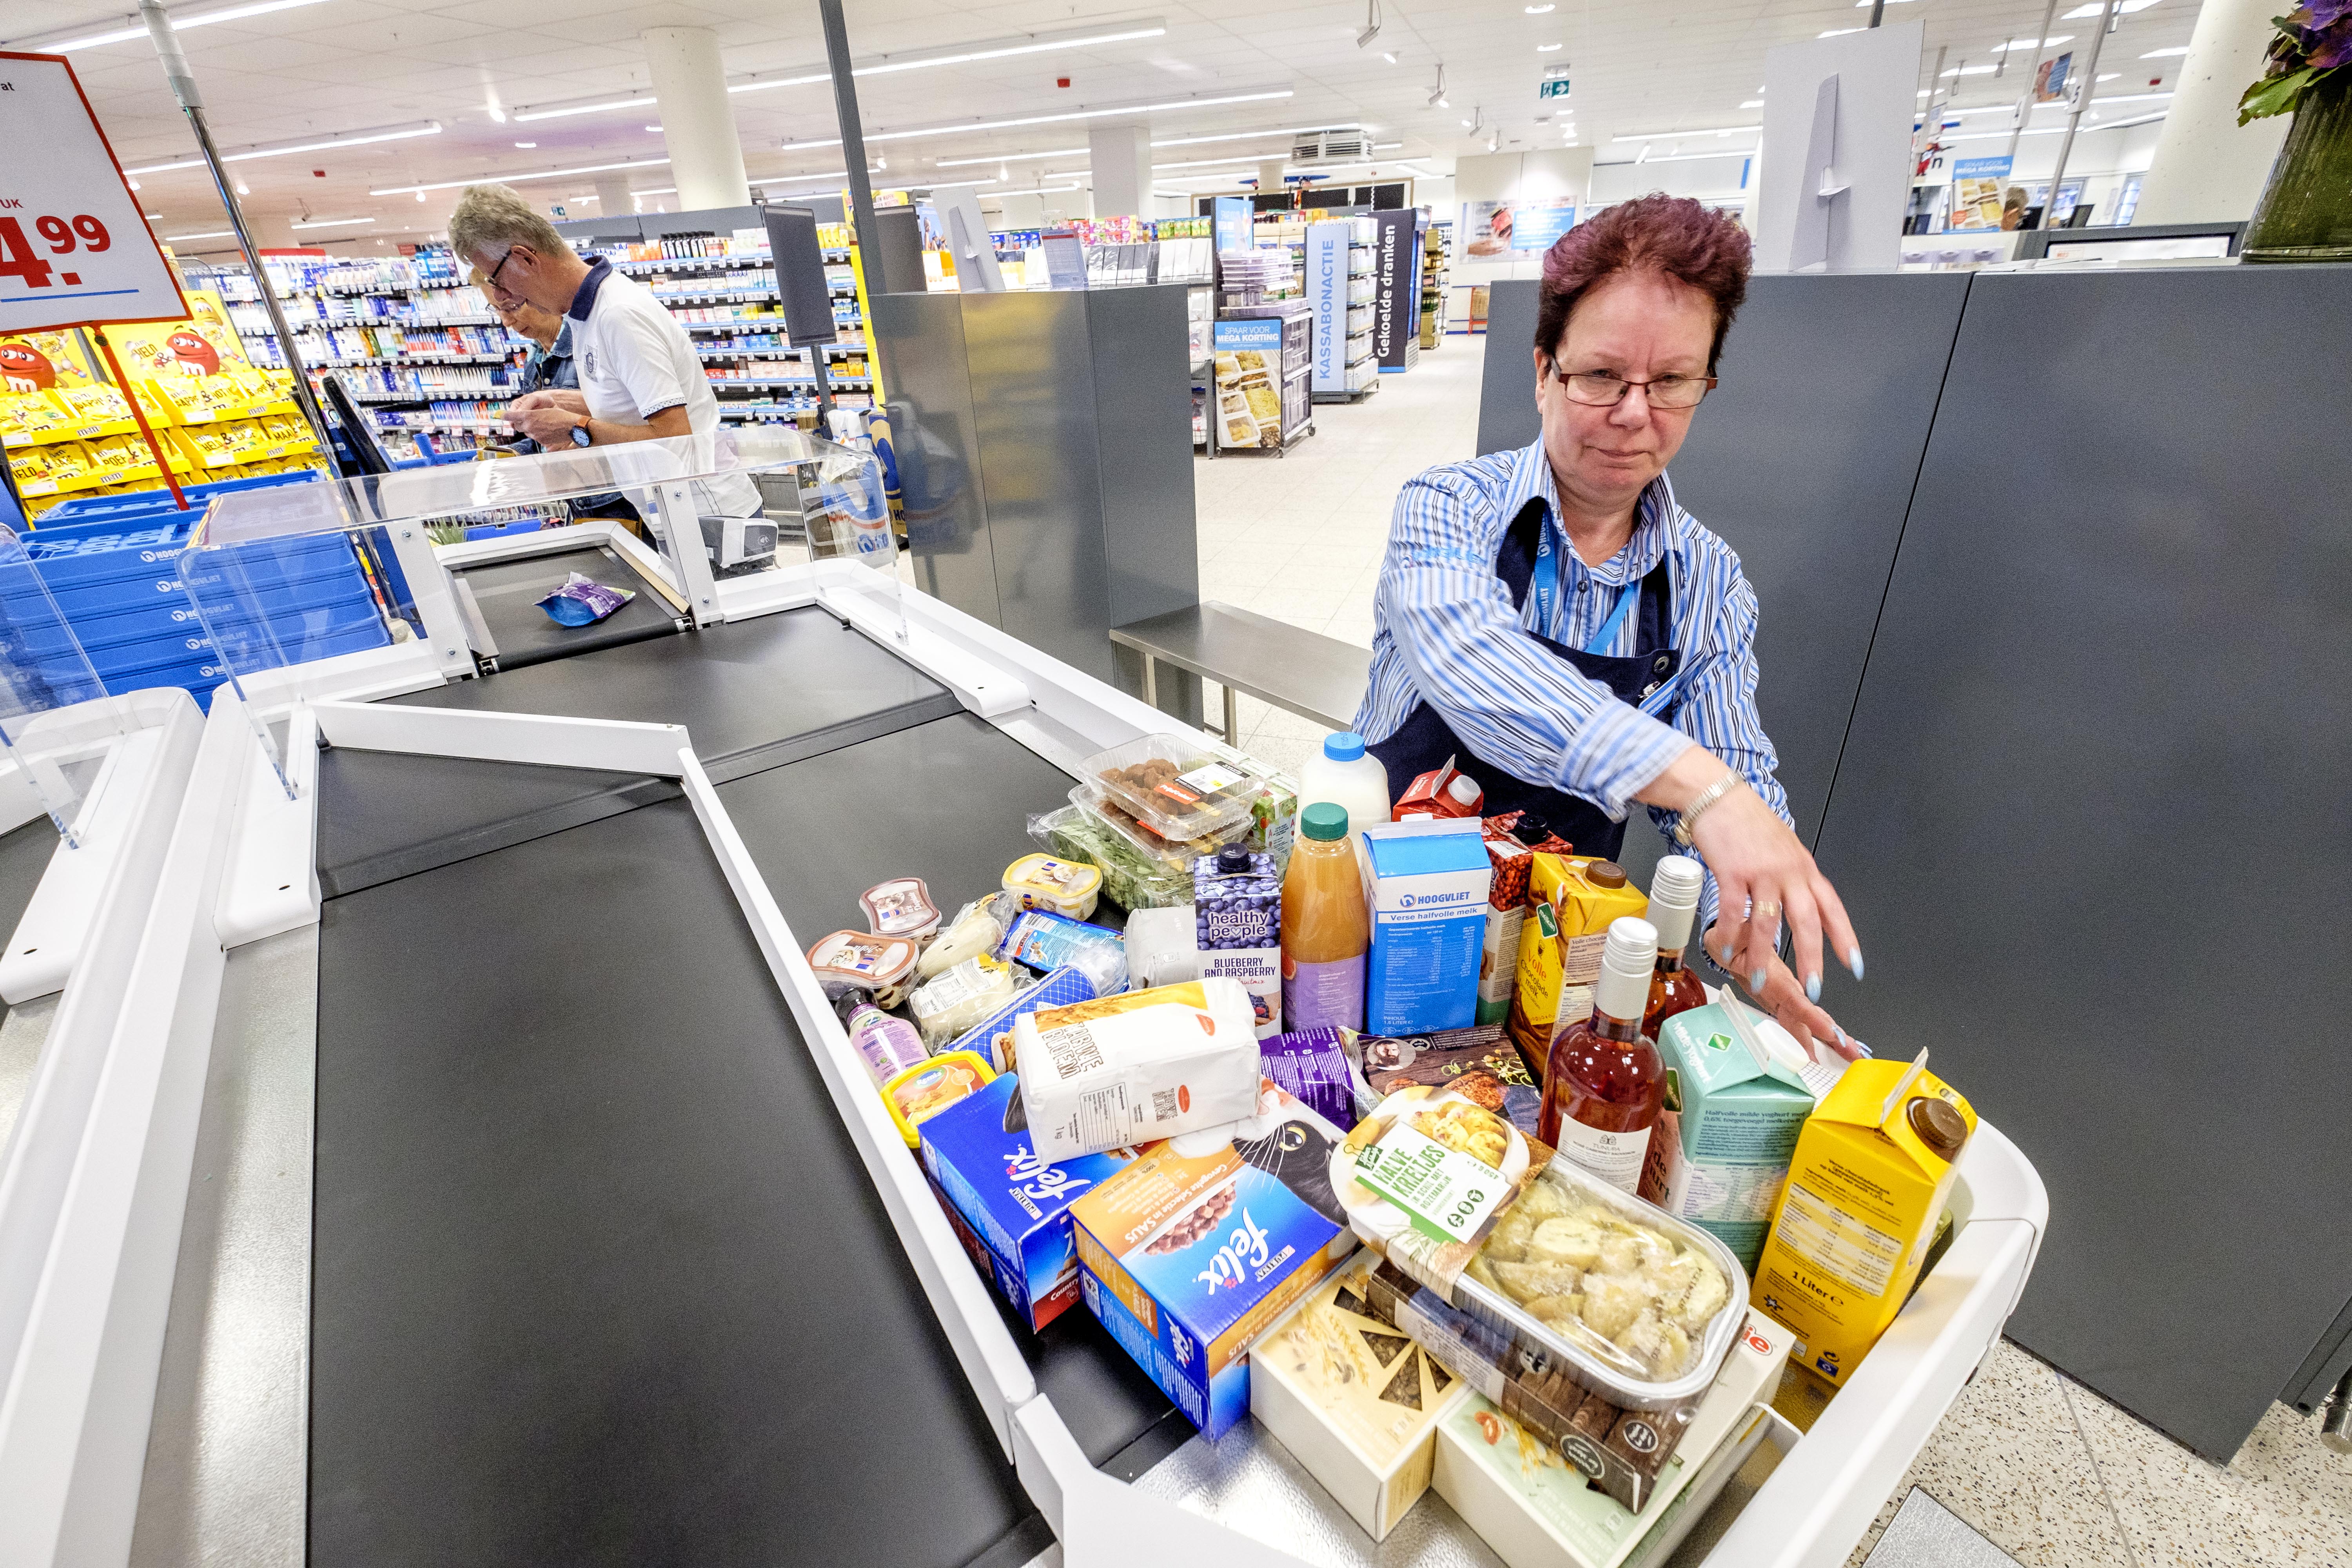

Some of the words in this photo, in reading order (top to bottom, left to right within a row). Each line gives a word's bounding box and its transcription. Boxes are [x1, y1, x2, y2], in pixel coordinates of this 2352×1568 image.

[1381, 225, 1396, 286] dranken
[1319, 241, 1334, 379] KASSABONACTIE
[1242, 334, 1279, 342] KORTING
[1377, 291, 1392, 358] Gekoelde
[1210, 912, 1269, 926] healthy
[1417, 910, 1455, 920] halfvolle
[1205, 968, 1223, 978] AND
[1225, 966, 1276, 978] RASPBERRY
[1214, 957, 1264, 968] BLUEBERRY
[1528, 949, 1547, 981] Volle
[1521, 959, 1548, 999] Chocolade
[1525, 978, 1539, 998] melk
[1042, 1028, 1082, 1080] BLOEM
[1064, 1022, 1103, 1072] TARWE
[916, 1071, 942, 1085] Remia
[1152, 1092, 1167, 1122] BLOEM
[1166, 1087, 1178, 1120] TARWE
[1189, 1163, 1227, 1190] Gevogelte
[1372, 1147, 1413, 1185] HALVE
[1391, 1145, 1445, 1198] KRIELTJES
[1430, 1168, 1445, 1181] MET
[1163, 1190, 1190, 1212] Selectie
[1125, 1217, 1158, 1244] SAUS
[1197, 1206, 1269, 1296] felix
[1256, 1250, 1287, 1278] PURINA
[1800, 1276, 1828, 1298] Liter
[1229, 1332, 1254, 1359] SAUS
